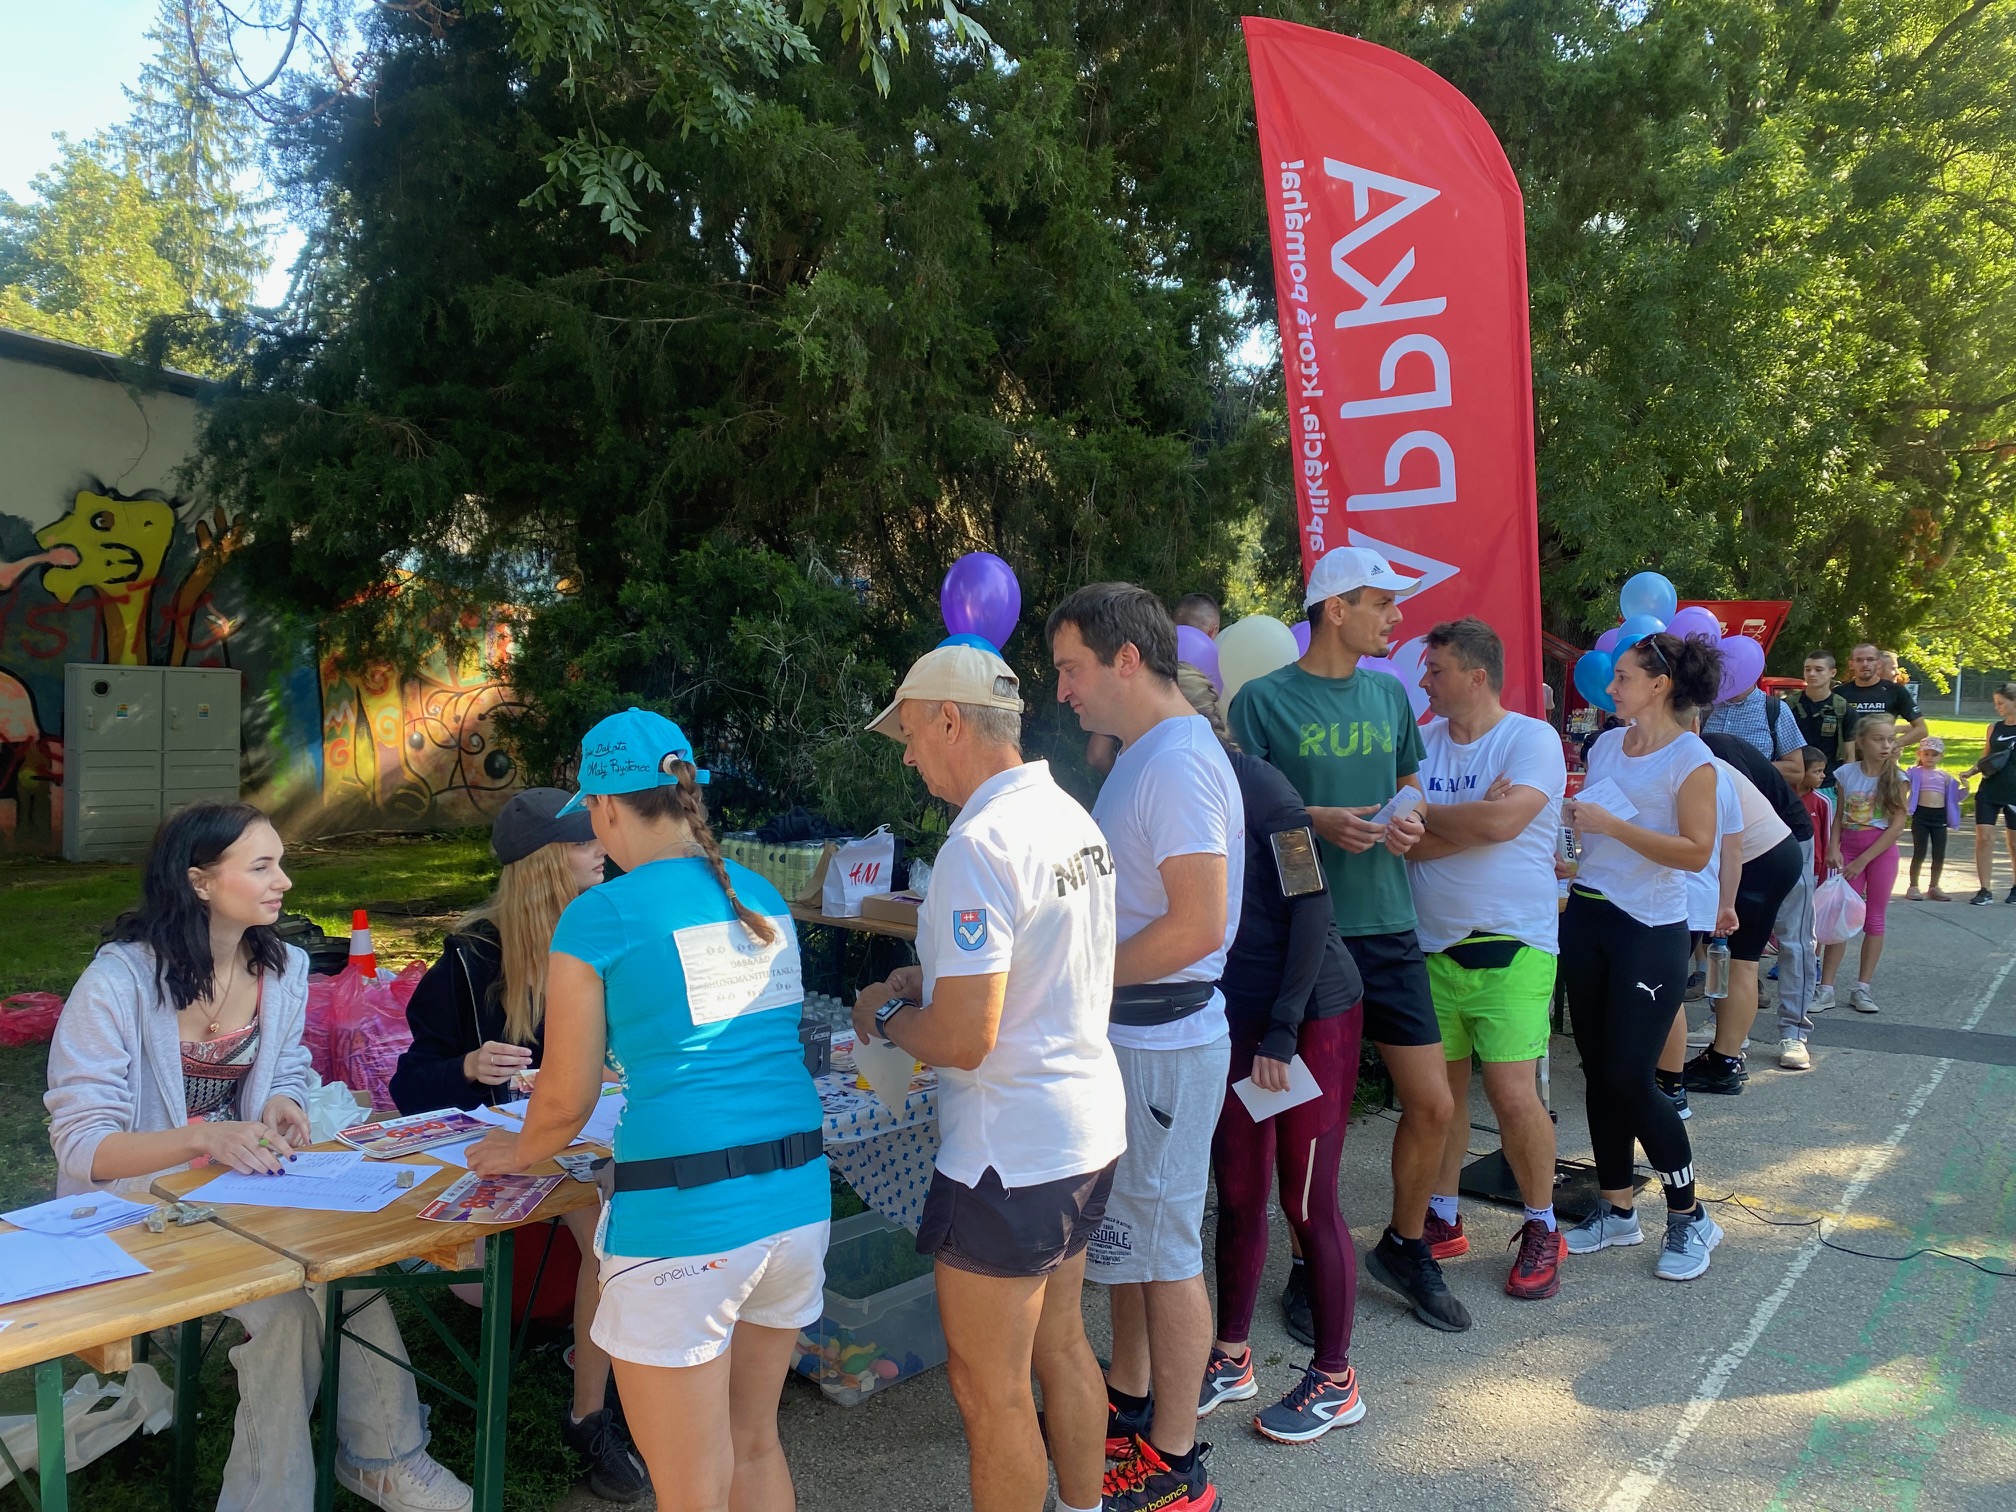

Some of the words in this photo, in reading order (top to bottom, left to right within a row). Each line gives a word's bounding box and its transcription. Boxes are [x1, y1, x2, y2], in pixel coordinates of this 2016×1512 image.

[1298, 720, 1394, 757] RUN
[1564, 828, 1575, 860] OSHEE
[848, 862, 881, 886] H&M
[1657, 1160, 1694, 1189] PU
[1148, 1484, 1188, 1511] balance
